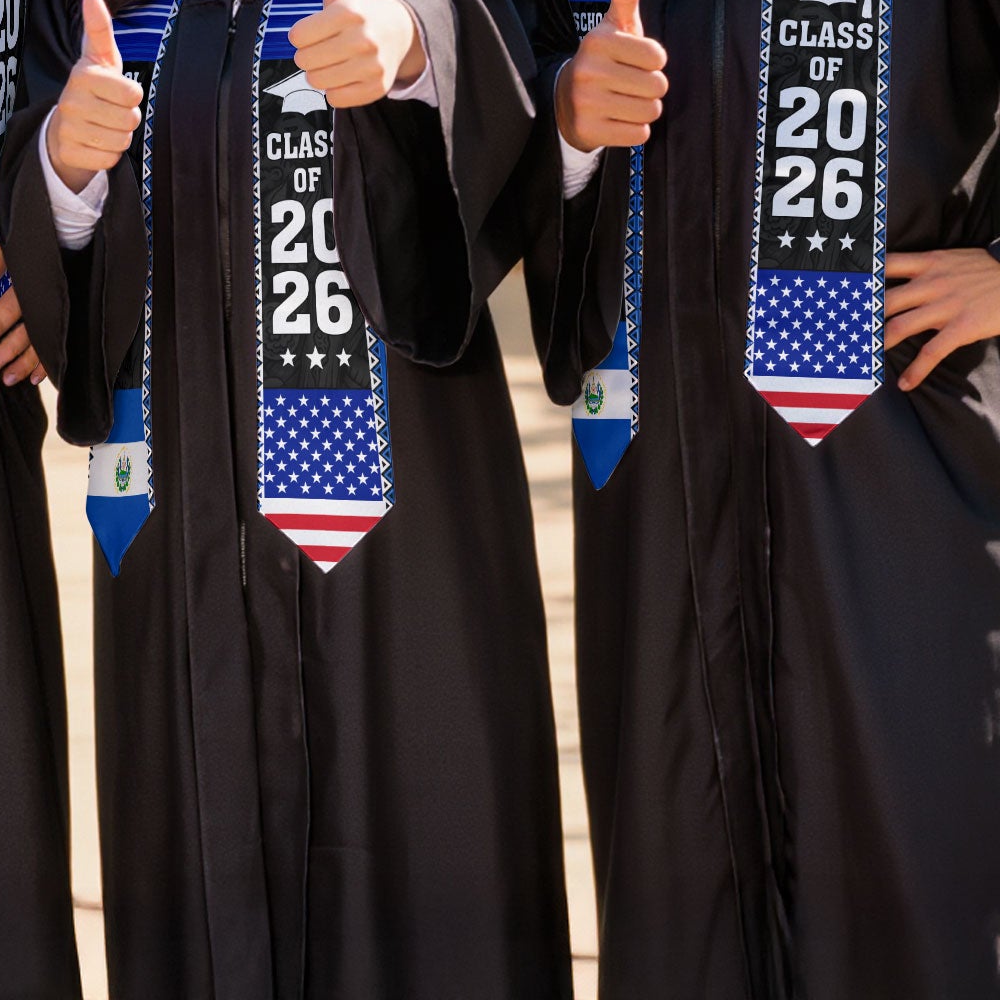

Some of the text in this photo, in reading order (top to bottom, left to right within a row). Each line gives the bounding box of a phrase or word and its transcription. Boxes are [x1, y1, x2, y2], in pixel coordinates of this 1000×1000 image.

[778, 19, 874, 50] CLASS
[809, 56, 843, 82] OF
[775, 86, 868, 151] 20
[293, 167, 322, 193] OF
[771, 155, 864, 220] 26
[272, 270, 354, 335] 26
